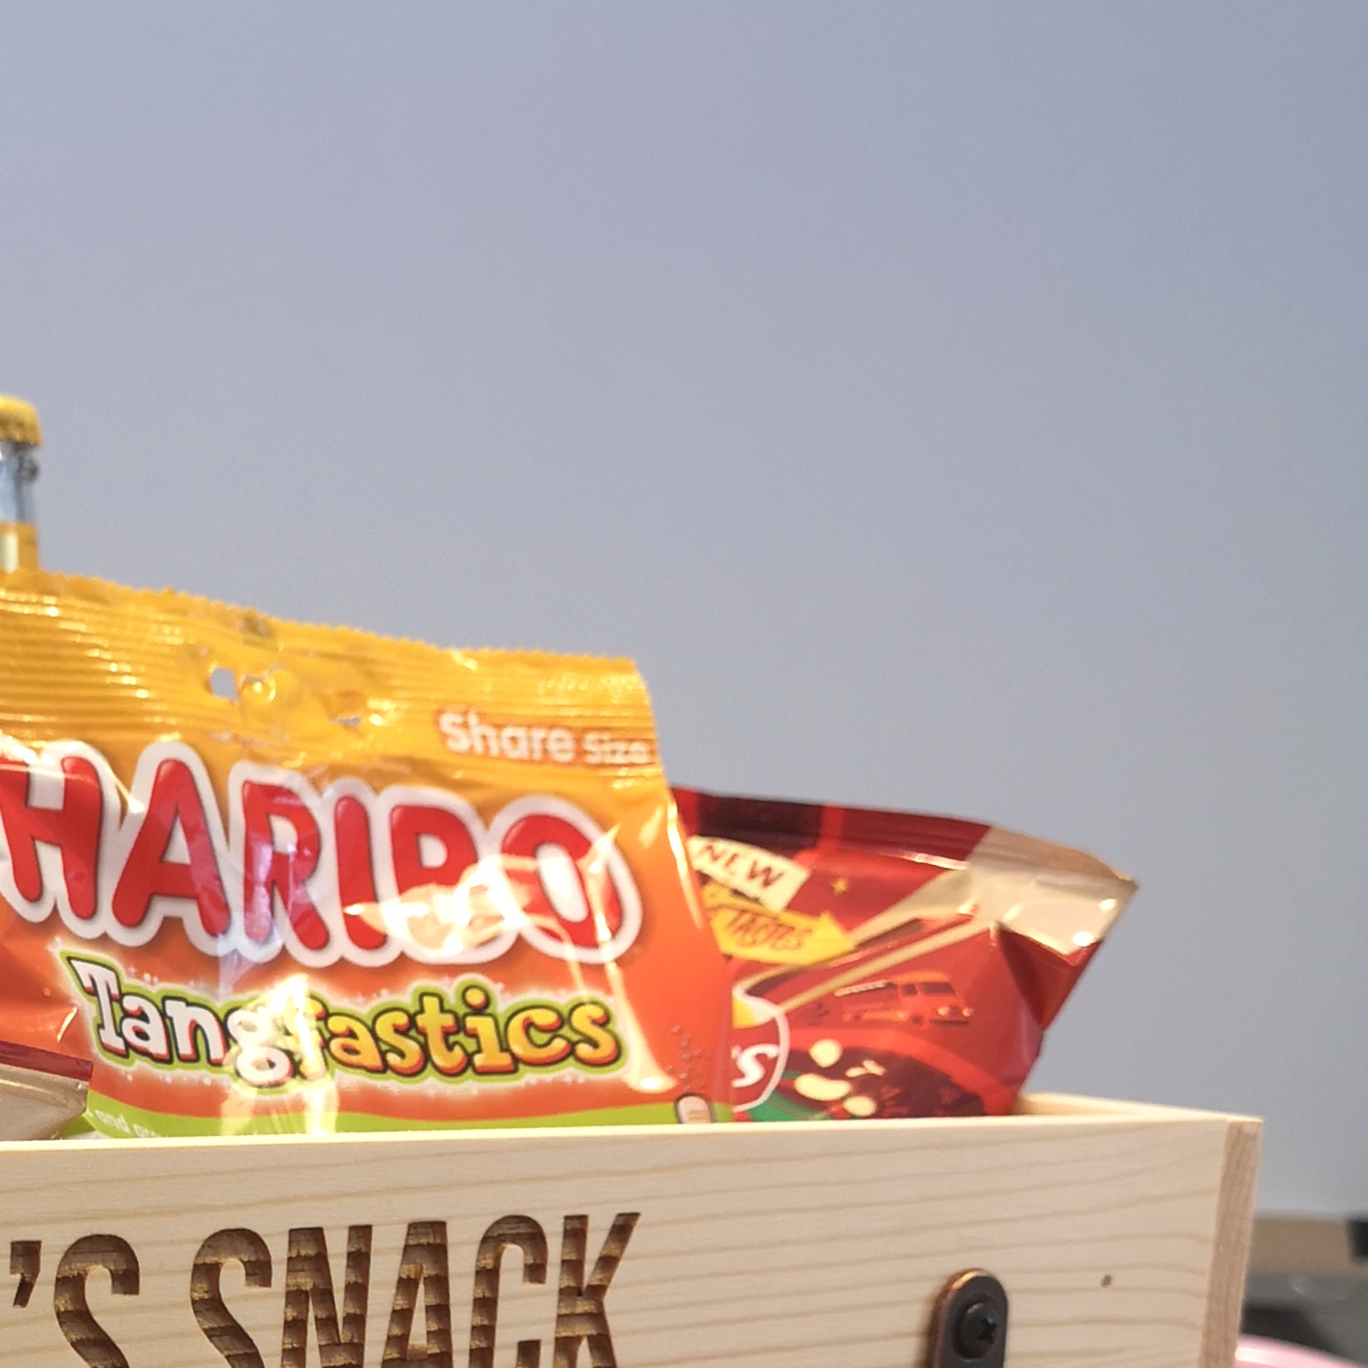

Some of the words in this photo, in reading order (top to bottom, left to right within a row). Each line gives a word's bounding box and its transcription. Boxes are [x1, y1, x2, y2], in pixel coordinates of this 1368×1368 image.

[438, 709, 577, 763] Share
[699, 843, 785, 889] NEW
[66, 954, 623, 1088] Tangfastics
